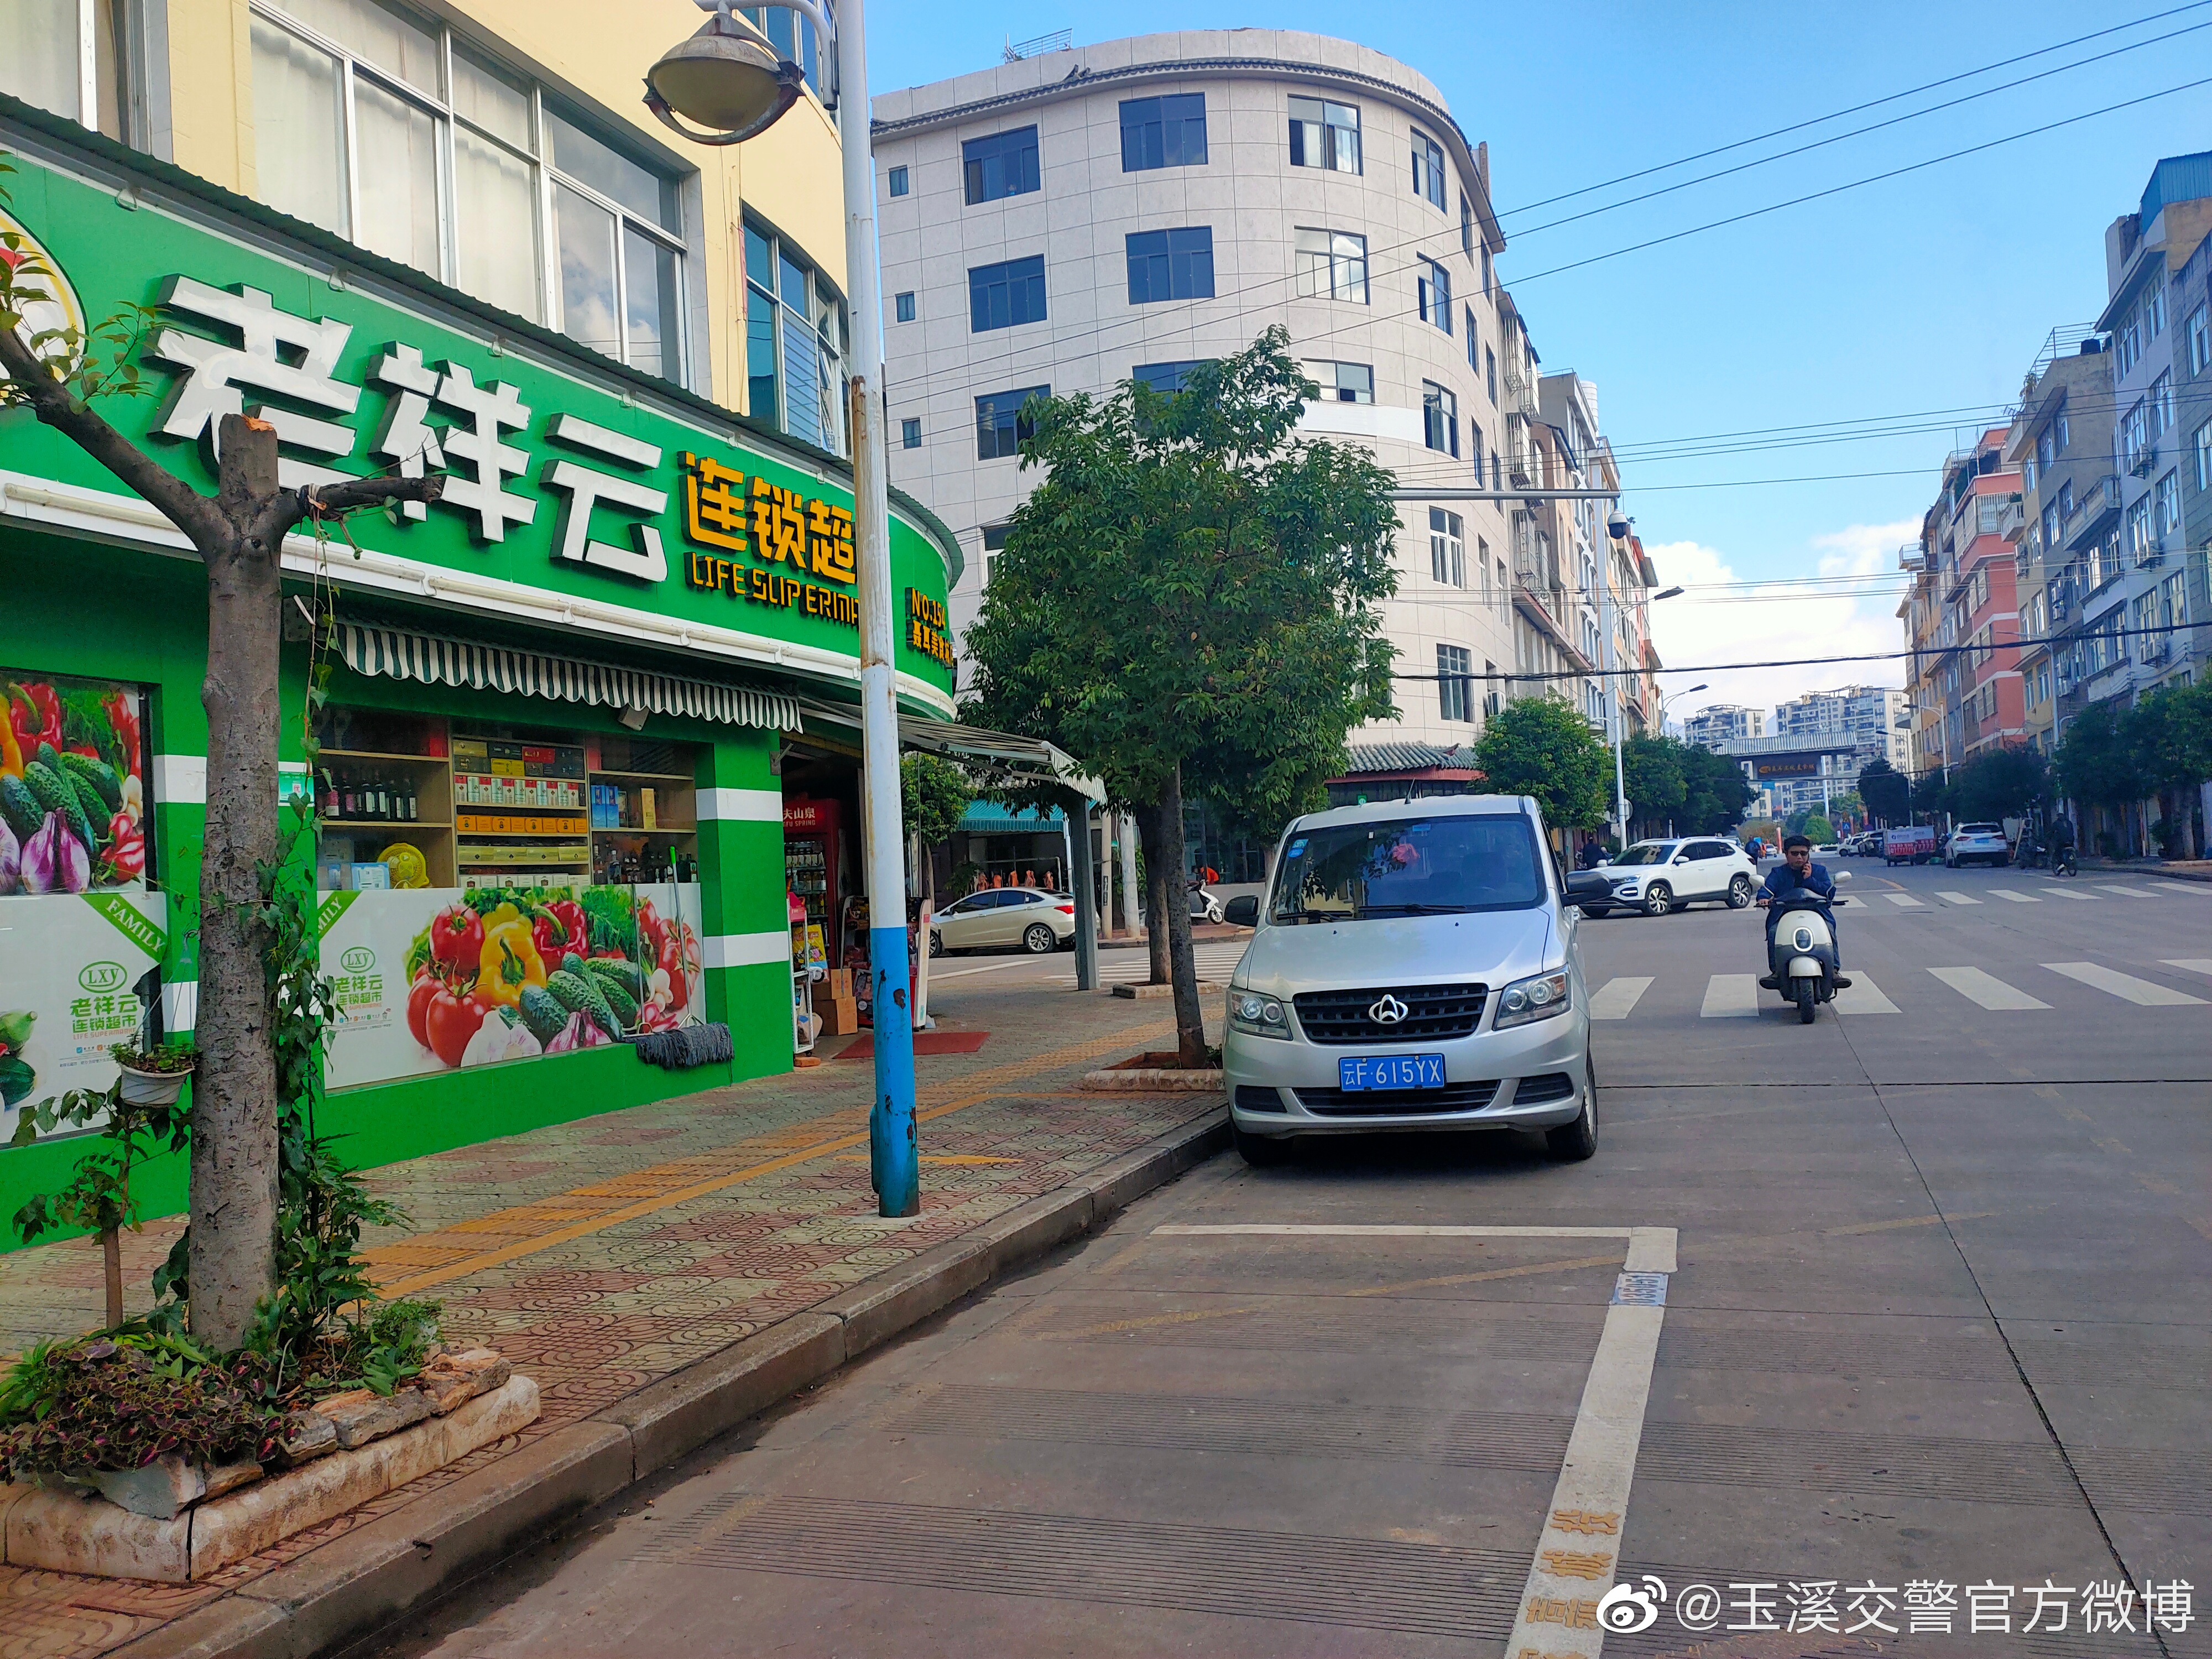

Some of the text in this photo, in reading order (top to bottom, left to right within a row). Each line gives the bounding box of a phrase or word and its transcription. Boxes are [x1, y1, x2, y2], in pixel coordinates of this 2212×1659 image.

[678, 451, 857, 585] 连锁超
[686, 551, 859, 625] LIFE SUPERMA
[911, 587, 946, 631] NO.154
[783, 807, 816, 820] 夫山泉
[105, 898, 165, 952] FAMILY
[318, 896, 342, 933] MILY
[335, 974, 383, 993] 老祥云
[70, 994, 138, 1018] 老祥云
[336, 992, 382, 1006] 连锁超市
[72, 1014, 136, 1033] 连锁超市
[1621, 1275, 1661, 1303] 035051
